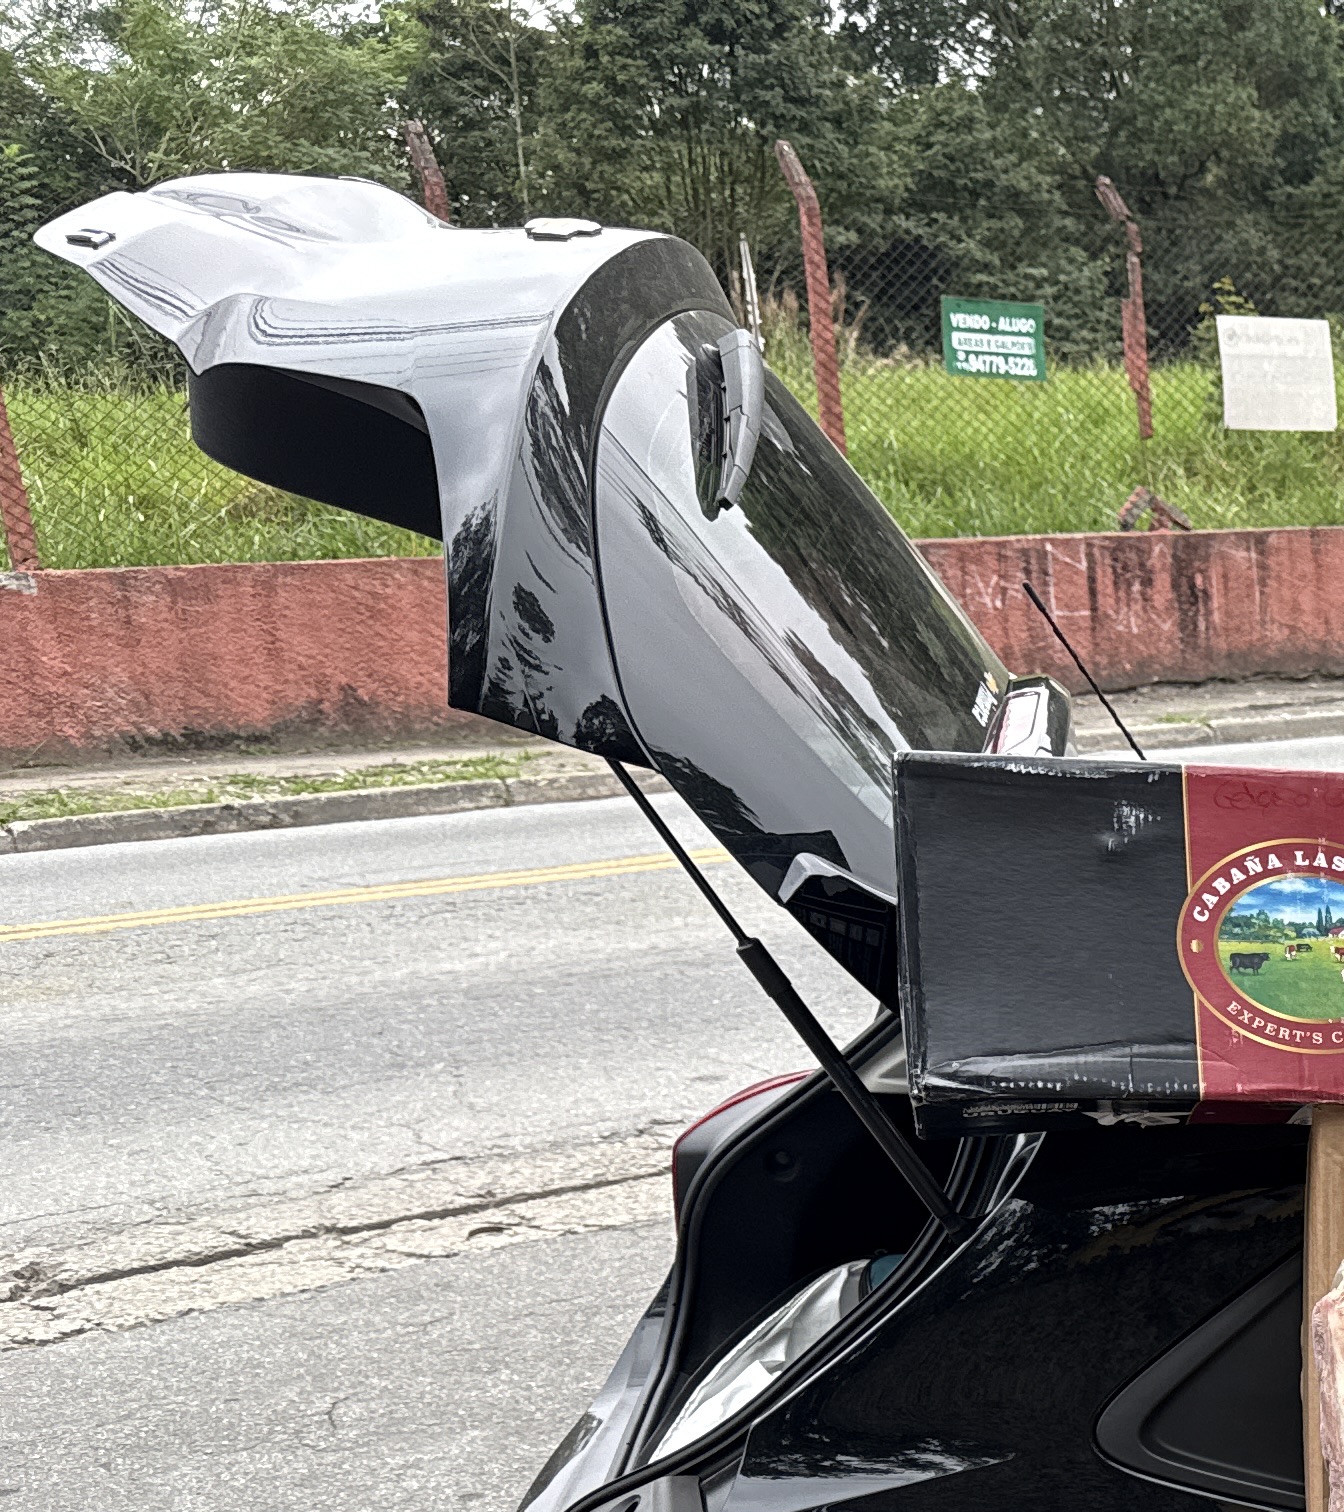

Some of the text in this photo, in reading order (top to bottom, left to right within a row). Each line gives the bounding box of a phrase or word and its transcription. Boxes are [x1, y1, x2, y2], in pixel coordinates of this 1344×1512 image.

[950, 312, 990, 330] VENDO
[998, 316, 1037, 333] ALUGO
[1193, 853, 1282, 923] CABAÑA
[1226, 1000, 1323, 1046] EXPERT'S
